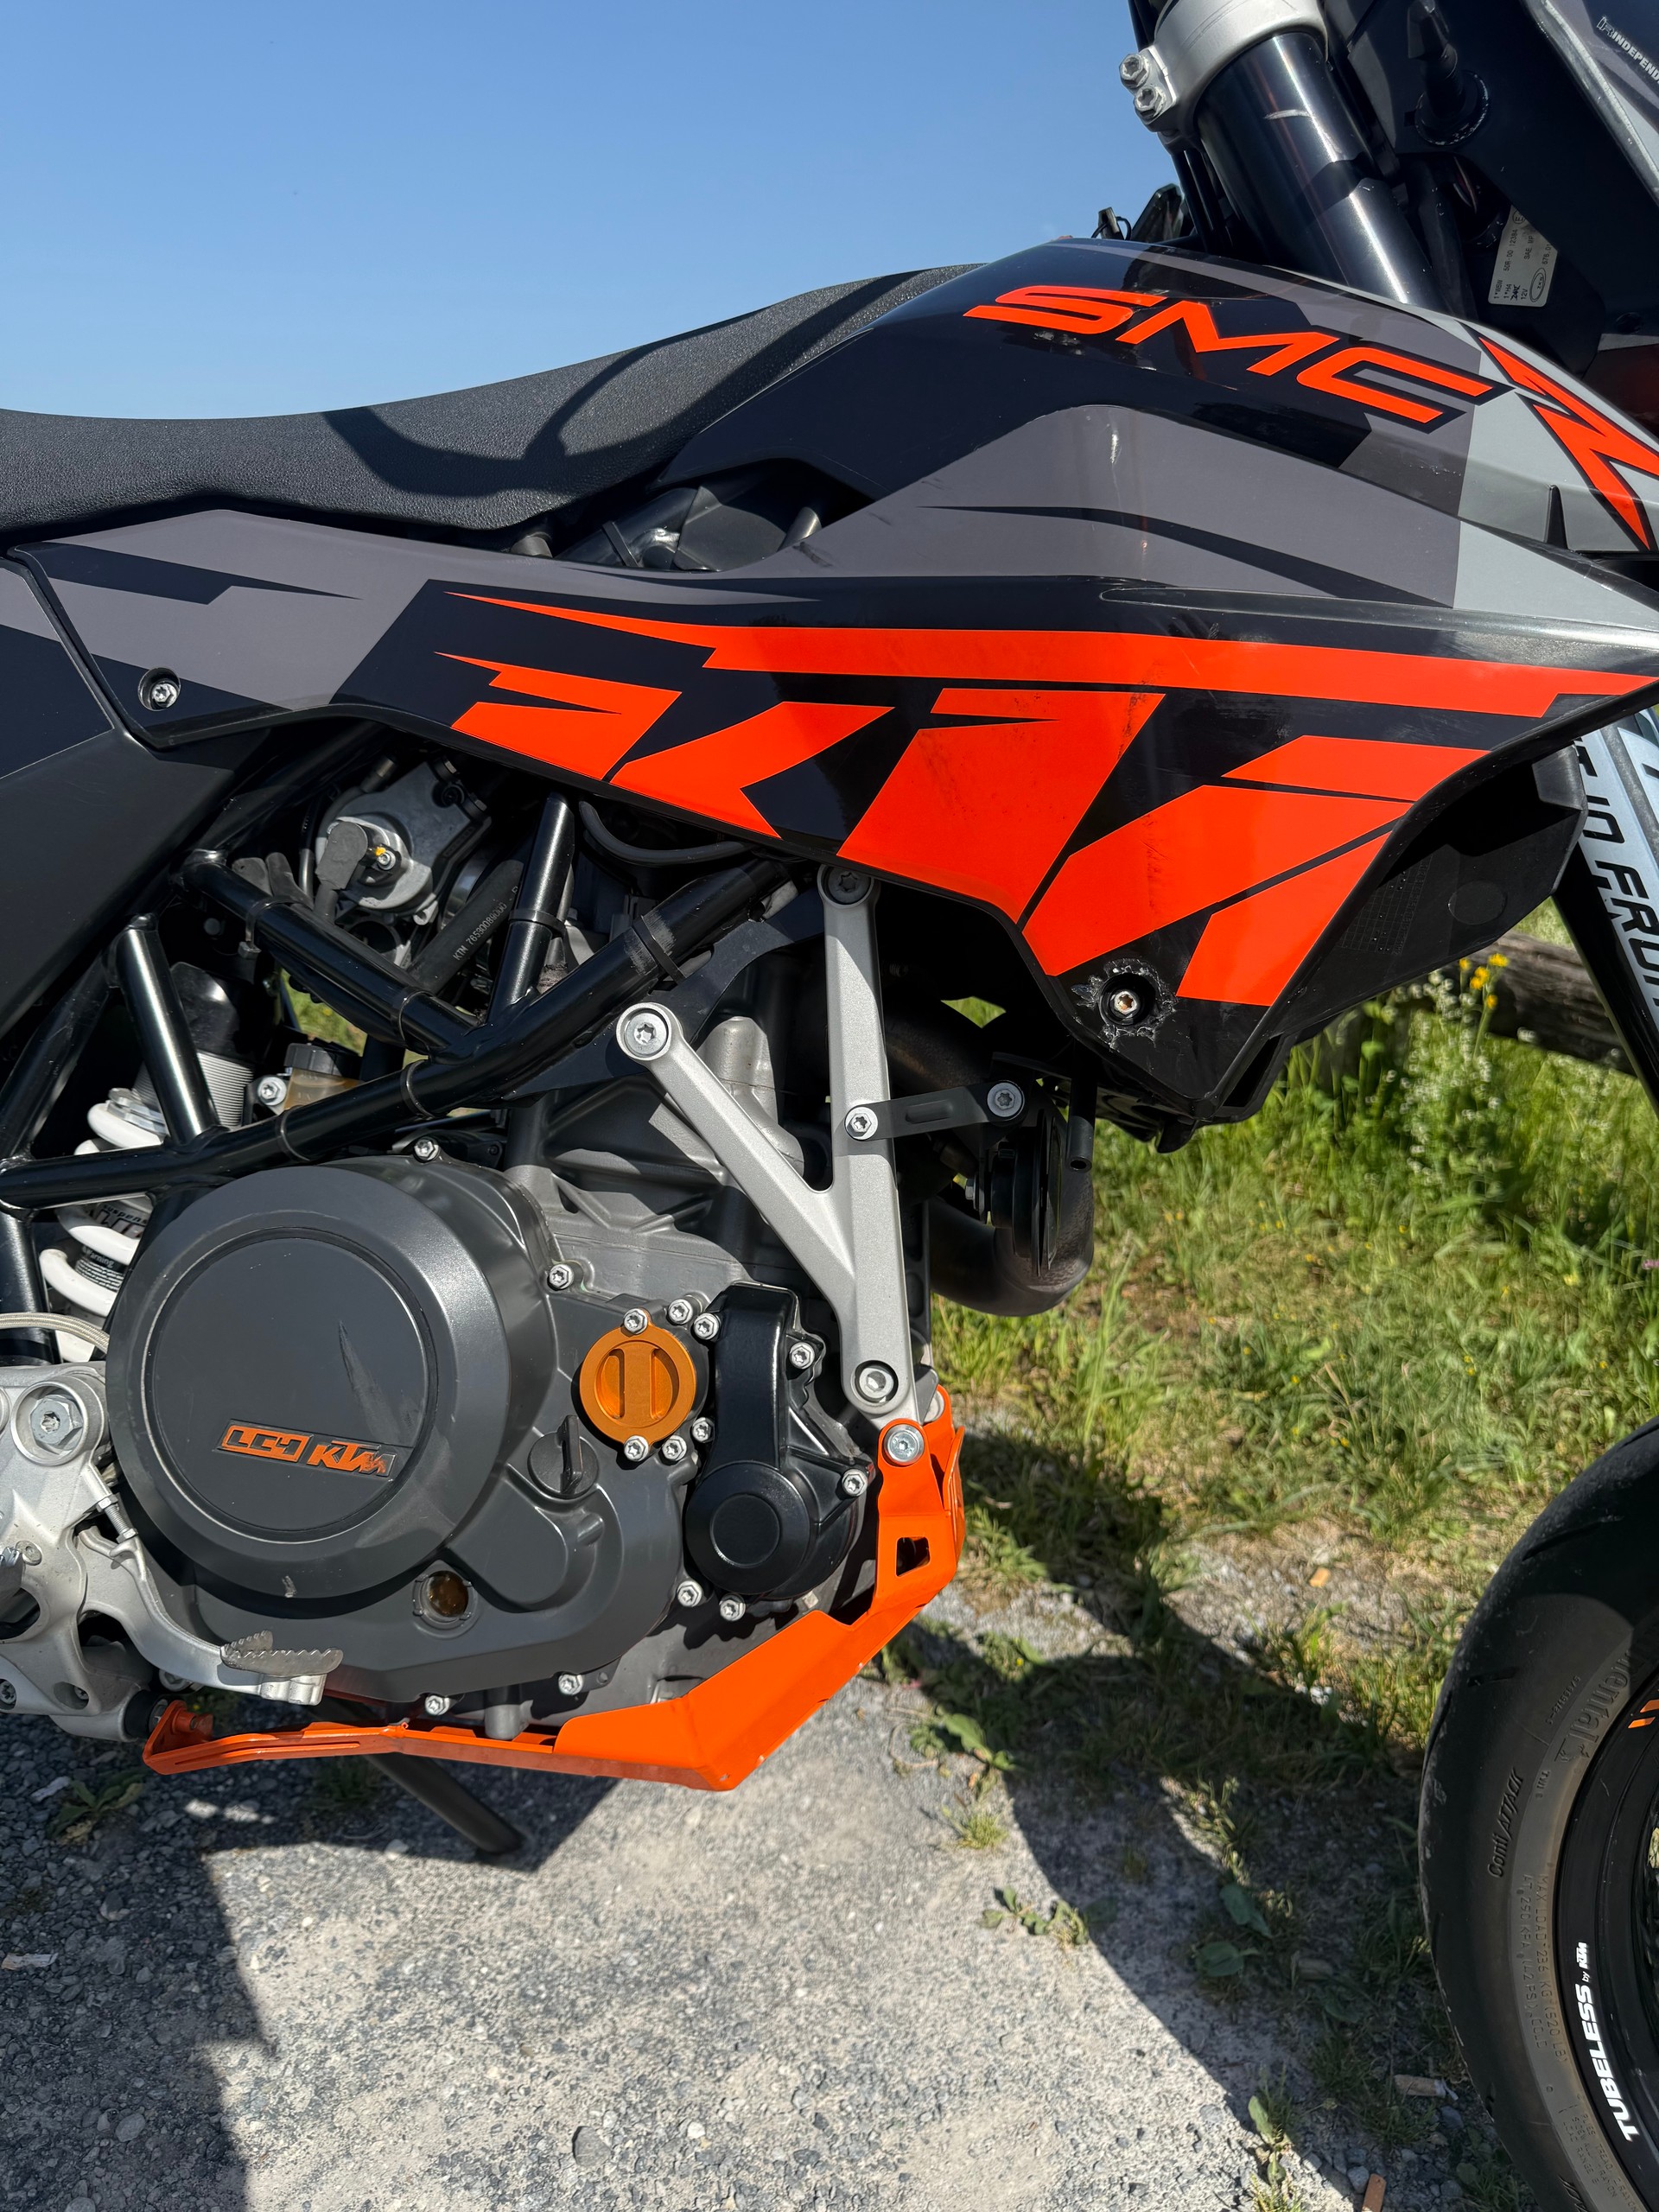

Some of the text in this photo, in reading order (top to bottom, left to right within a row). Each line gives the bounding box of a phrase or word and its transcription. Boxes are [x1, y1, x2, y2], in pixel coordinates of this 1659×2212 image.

[1612, 31, 1659, 85] INDEPEND
[963, 286, 1493, 424] SMC
[306, 1440, 397, 1478] KTM
[1536, 1873, 1548, 1901] MAX
[1535, 1908, 1547, 1941] LOAD
[1575, 1942, 1640, 2142] TUBELESS by KTM
